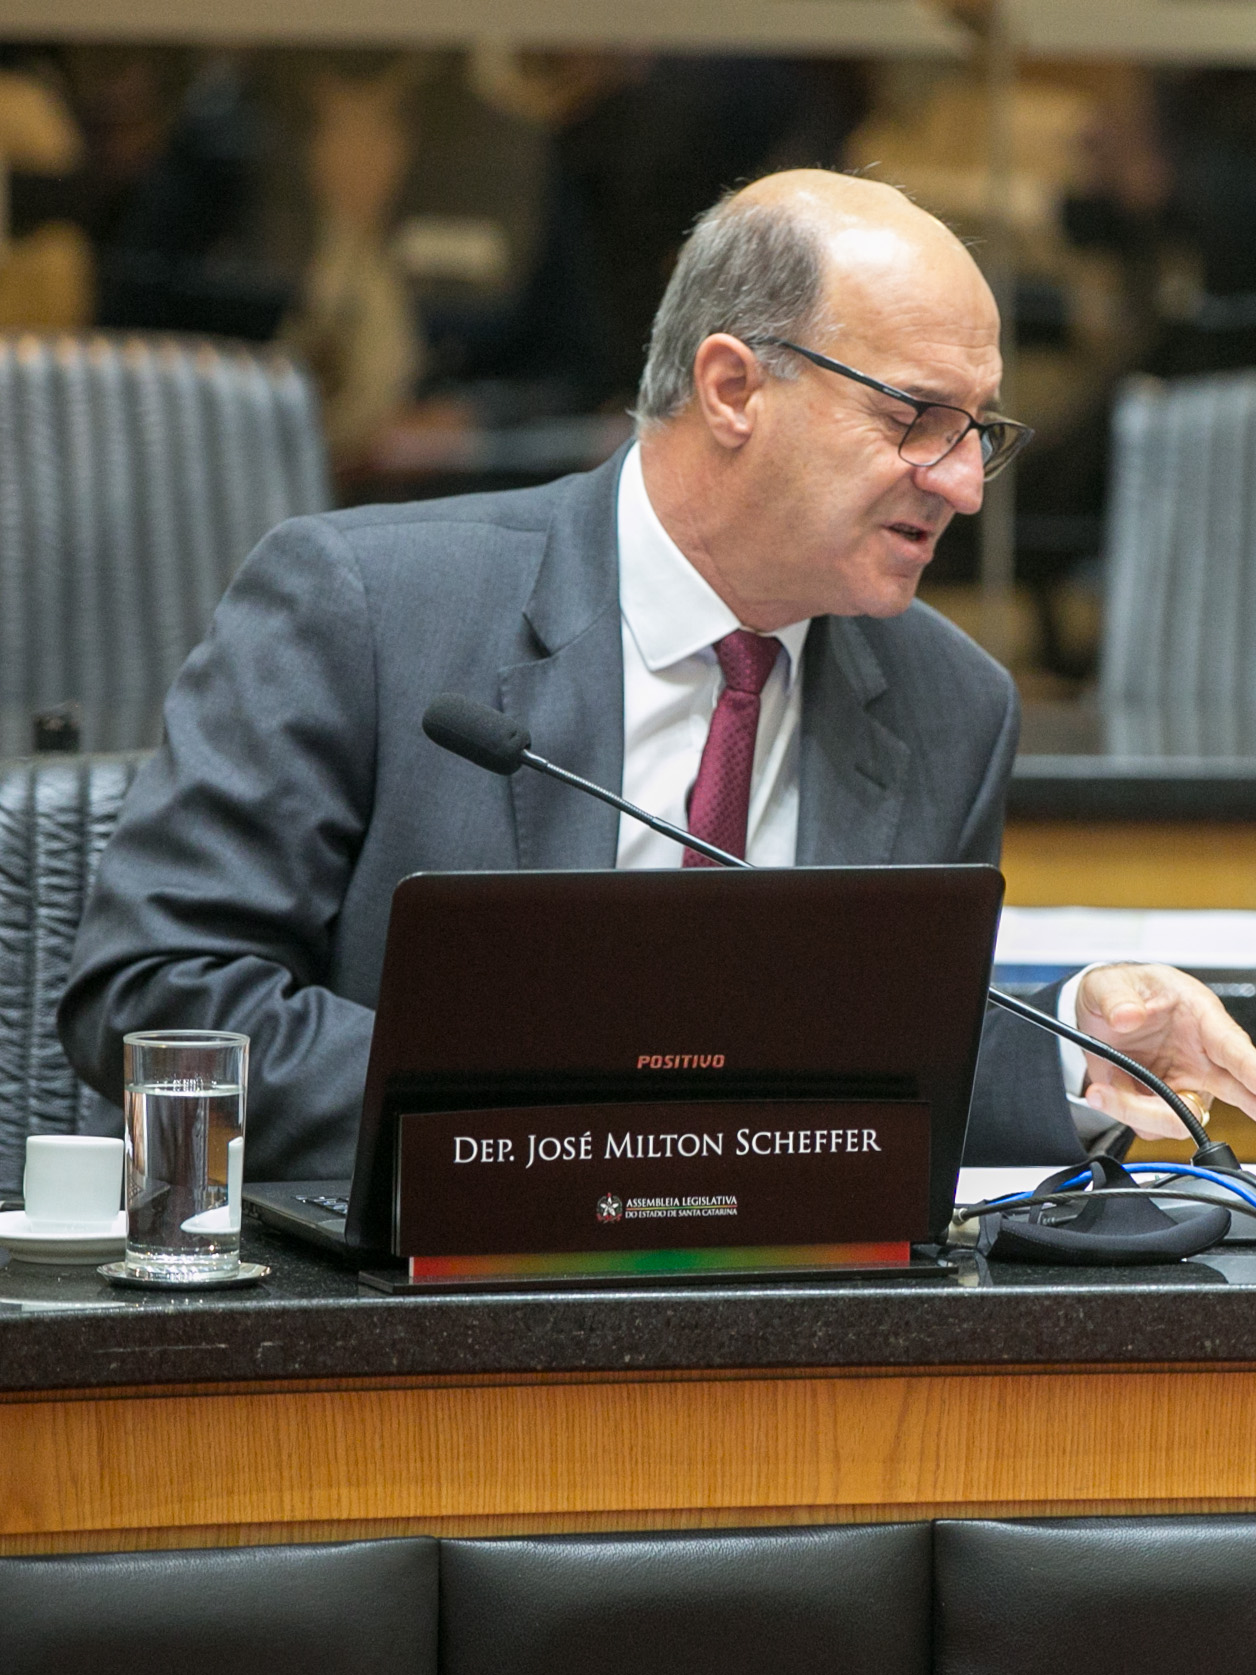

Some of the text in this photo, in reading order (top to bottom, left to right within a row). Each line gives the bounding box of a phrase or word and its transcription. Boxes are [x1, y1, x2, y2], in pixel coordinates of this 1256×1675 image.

[637, 1054, 726, 1069] POSITIVO
[453, 1128, 882, 1169] DEP. JOSÉ MILTON SCHEFFER
[626, 1195, 738, 1208] ASSEMBLEIA LEGISLATIVA
[625, 1207, 738, 1219] DO ESTADO DE SANTA CATARINA
